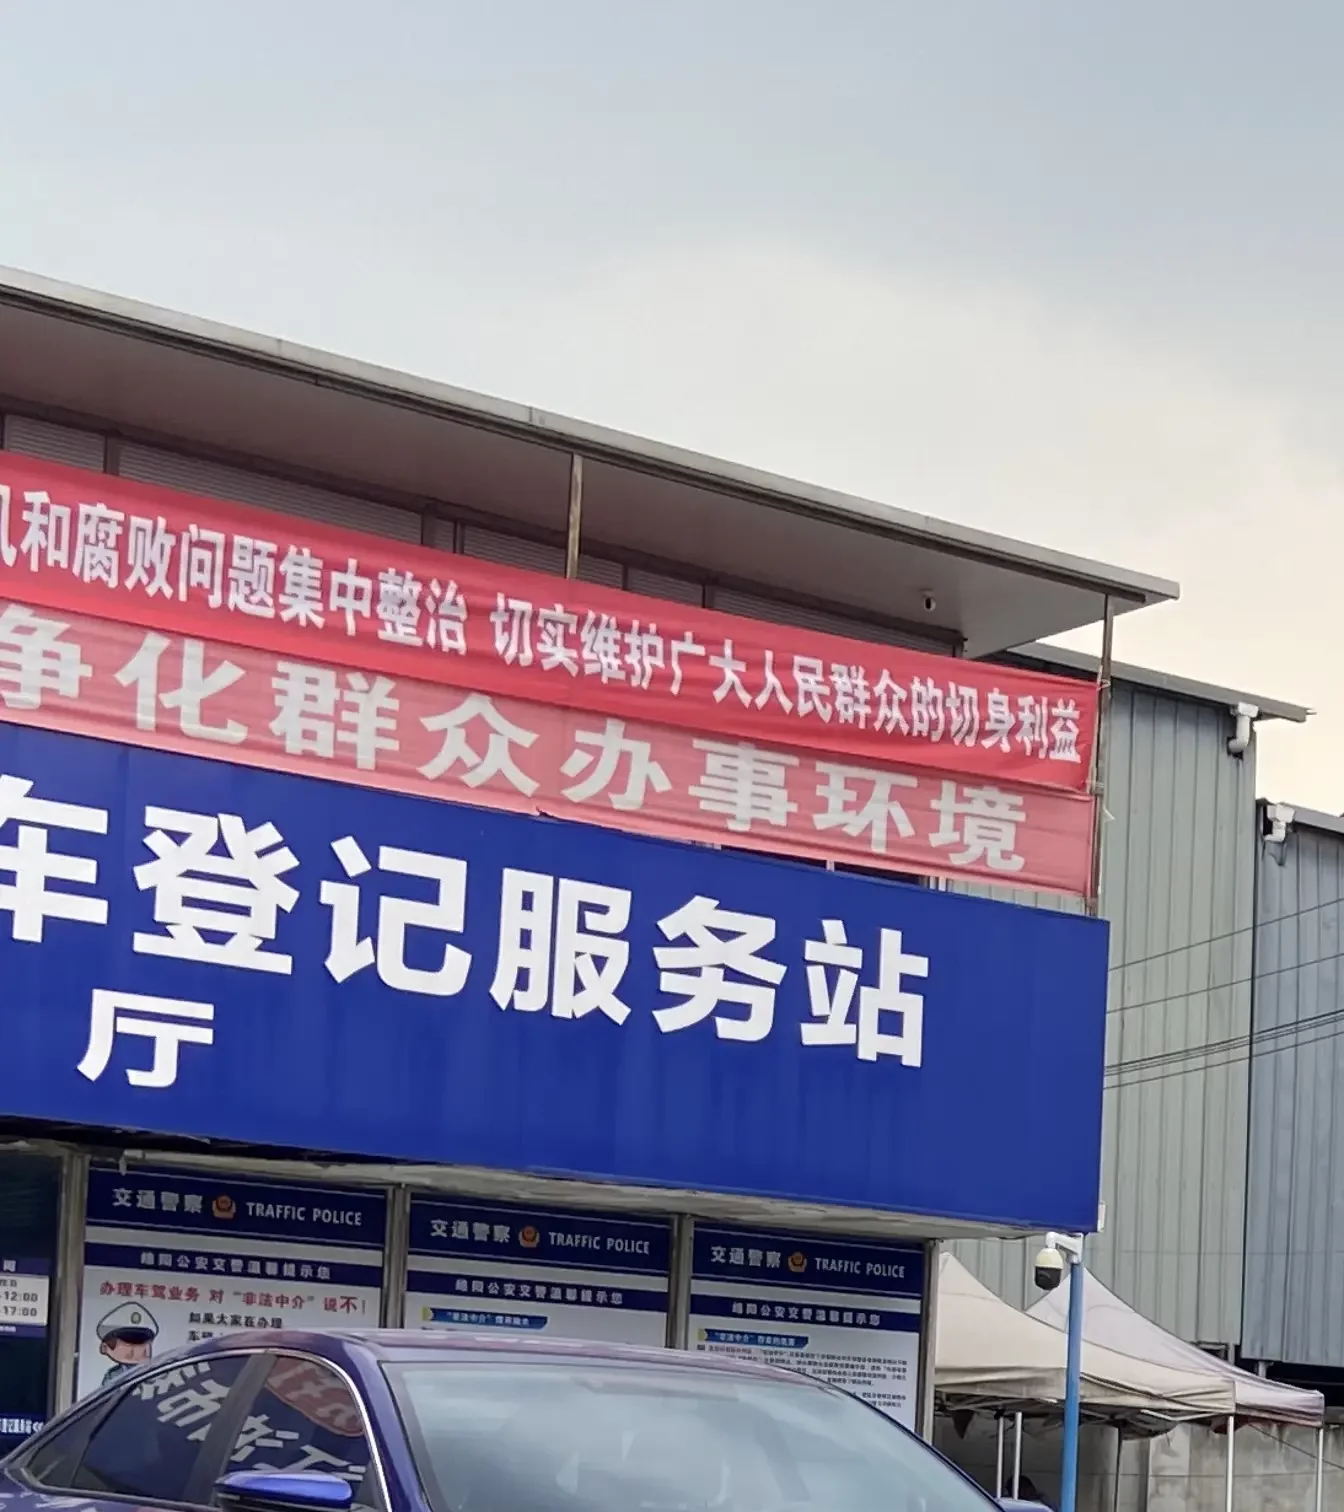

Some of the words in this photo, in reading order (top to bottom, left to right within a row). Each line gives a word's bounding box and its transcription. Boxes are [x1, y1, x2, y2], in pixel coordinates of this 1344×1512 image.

[493, 592, 1083, 764] 切实维护广大人民群众的切身利益
[0, 774, 929, 1068] 车登记服务站
[78, 989, 215, 1089] 厅
[112, 1187, 203, 1214] 交通警察
[246, 1201, 306, 1222] TRAFFIC
[312, 1207, 362, 1227] POLICE
[430, 1219, 510, 1244] 交通警察
[549, 1231, 600, 1249] TRAFFIC
[607, 1237, 650, 1255] POLICE
[711, 1245, 781, 1268] 交通警察
[815, 1256, 861, 1274] TRAFFIC
[865, 1262, 905, 1278] POLICE
